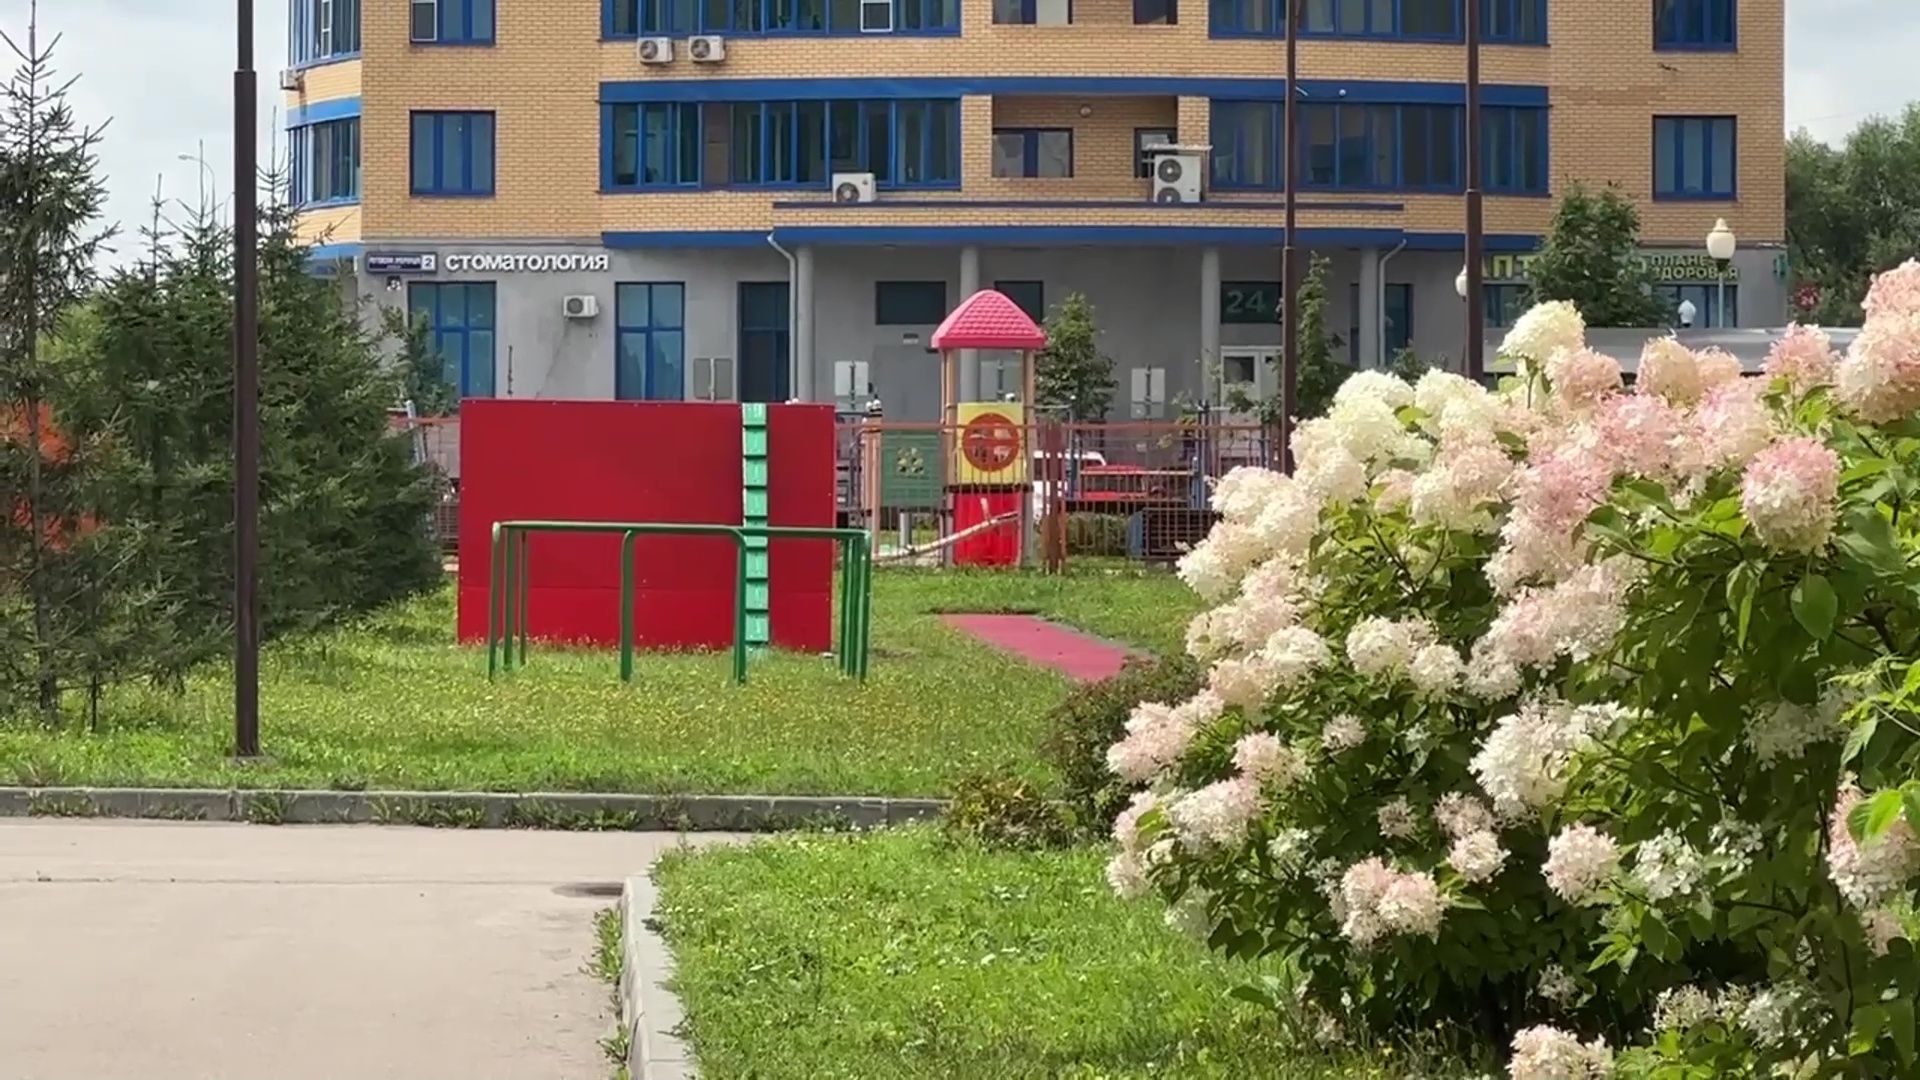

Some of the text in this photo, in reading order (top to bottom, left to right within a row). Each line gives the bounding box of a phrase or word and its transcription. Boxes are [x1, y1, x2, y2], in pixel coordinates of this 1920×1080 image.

[424, 257, 432, 267] 2
[1651, 255, 1728, 266] ПЛАНЕ
[1226, 290, 1266, 313] 24
